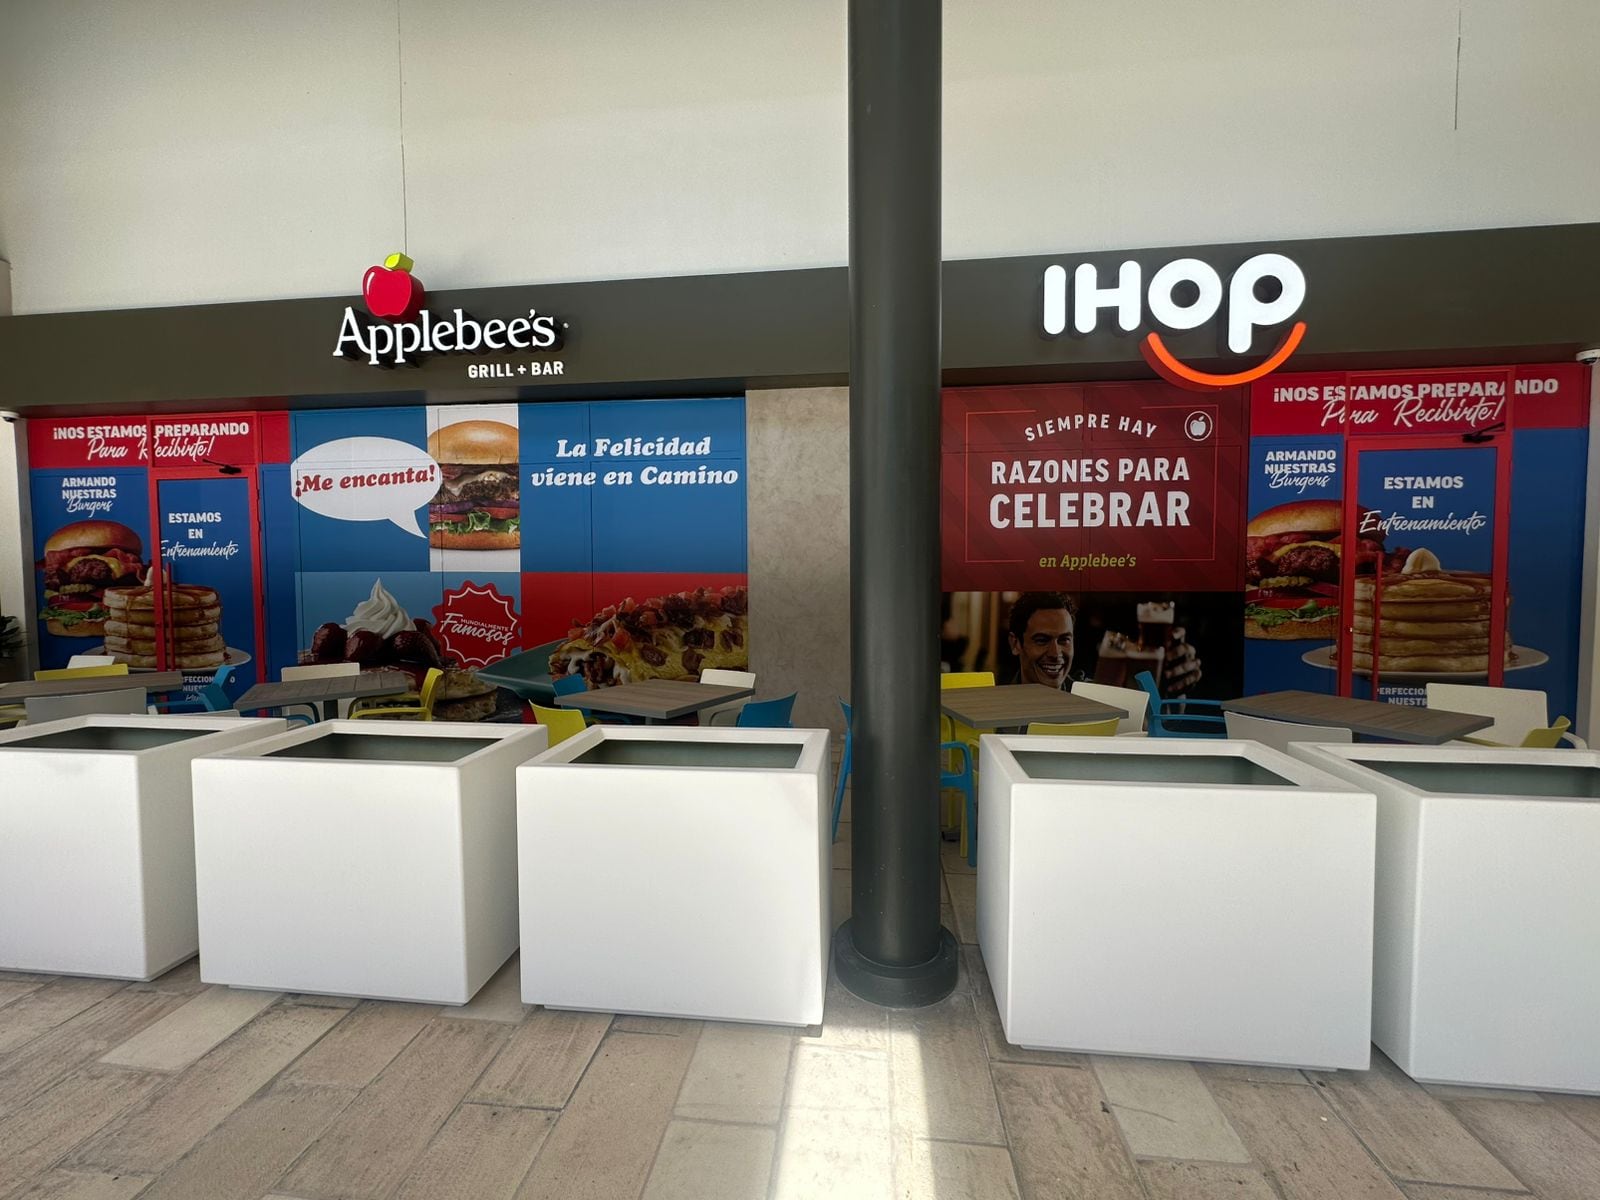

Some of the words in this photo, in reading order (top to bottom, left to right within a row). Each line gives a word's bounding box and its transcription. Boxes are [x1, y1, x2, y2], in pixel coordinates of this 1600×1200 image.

[1043, 253, 1306, 354] IHOP
[333, 306, 556, 366] Applebee's
[468, 363, 514, 378] GRILL
[531, 360, 564, 376] BAR
[1273, 387, 1319, 402] ¡NOS
[1393, 396, 1505, 428] Recibirte!
[54, 426, 85, 440] ¡NOS
[154, 421, 249, 437] PREPARANDO
[1024, 413, 1110, 441] SIEMPRE
[1118, 415, 1157, 439] HAY
[87, 437, 128, 461] Para
[138, 434, 215, 462] Recibirte!
[556, 439, 586, 458] La
[594, 436, 711, 457] Felicidad
[1265, 450, 1336, 461] ARMANDO
[531, 468, 596, 487] viene
[603, 470, 633, 486] en
[640, 465, 739, 486] Camino
[991, 458, 1110, 484] RAZONES
[1118, 457, 1190, 482] PARA
[1264, 463, 1336, 474] NUESTRAS
[62, 476, 116, 488] ARMANDO
[295, 473, 334, 497] ¡Me
[339, 464, 435, 489] encanta!
[1269, 470, 1330, 494] Burgers
[1384, 476, 1464, 490] ESTAMOS
[62, 489, 117, 500] NUESTRAS
[1412, 496, 1434, 509] EN
[66, 498, 113, 518] Burgers
[168, 512, 222, 524] ESTAMOS
[989, 491, 1191, 529] CELEBRAR
[1359, 510, 1486, 536] Entrenamiento
[188, 528, 203, 539] EN
[1039, 556, 1056, 568] en
[1060, 553, 1137, 571] Applebee's
[439, 612, 514, 646] Famosos
[460, 618, 510, 632] MUNDIALMENTE
